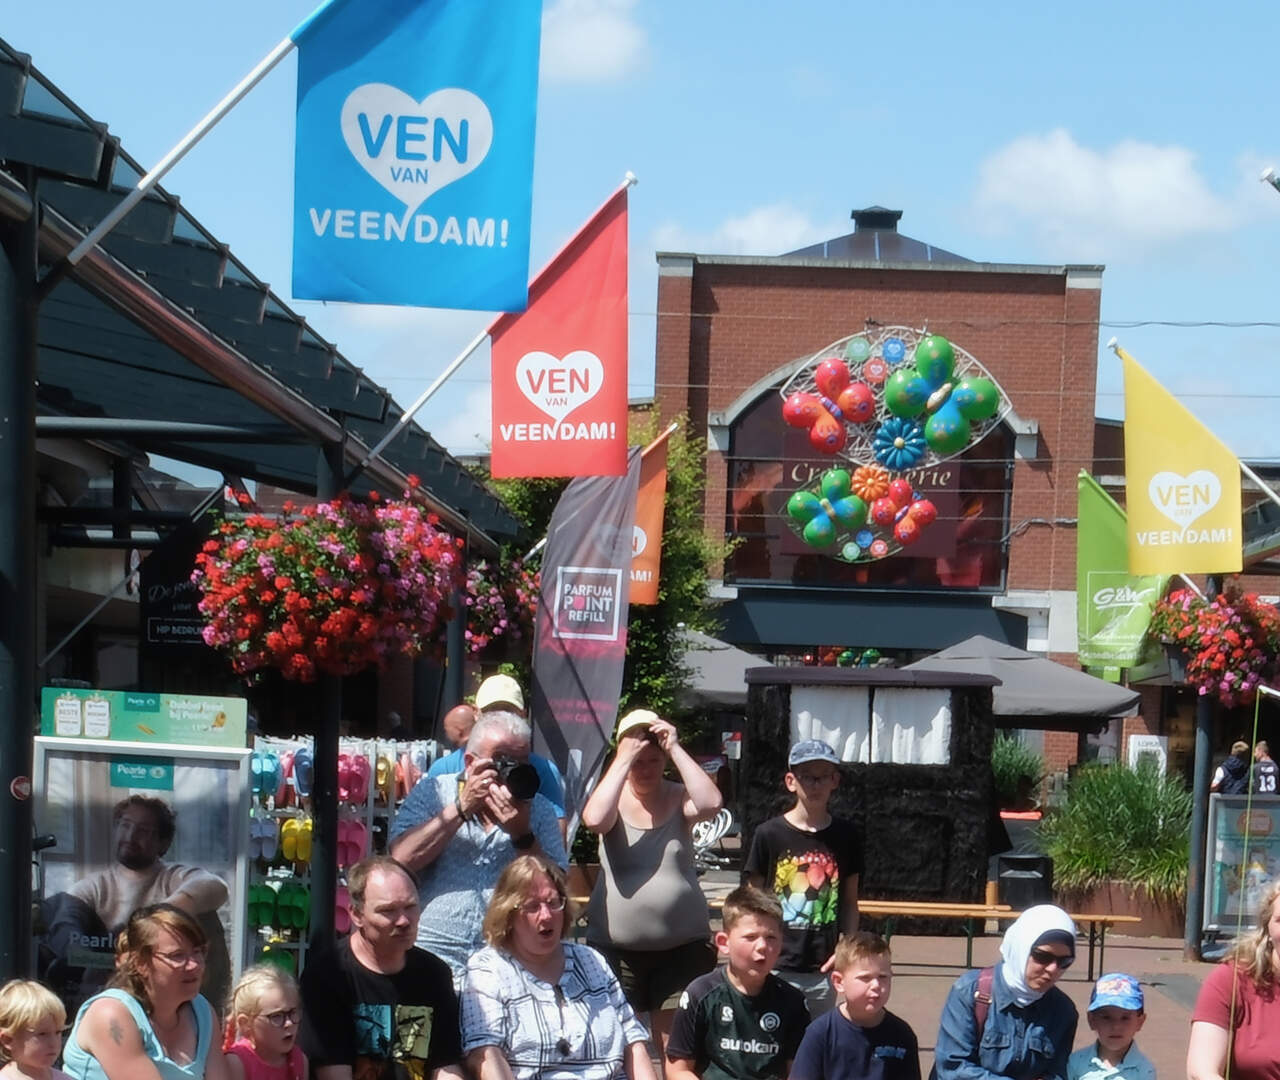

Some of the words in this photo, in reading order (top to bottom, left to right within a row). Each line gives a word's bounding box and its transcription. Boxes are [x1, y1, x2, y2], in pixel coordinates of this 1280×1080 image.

[357, 112, 470, 165] VEN
[390, 166, 429, 184] VAN
[308, 207, 510, 248] VEENDAM!
[526, 367, 590, 394] VEN
[545, 397, 568, 407] VAN
[500, 421, 617, 442] VEENDAM!
[1156, 484, 1211, 507] VEN
[1136, 527, 1233, 545] VEENDAM!
[563, 583, 613, 597] PARFUM
[568, 609, 606, 623] REFILL
[117, 763, 147, 776] Pearle
[1258, 775, 1277, 792] 13
